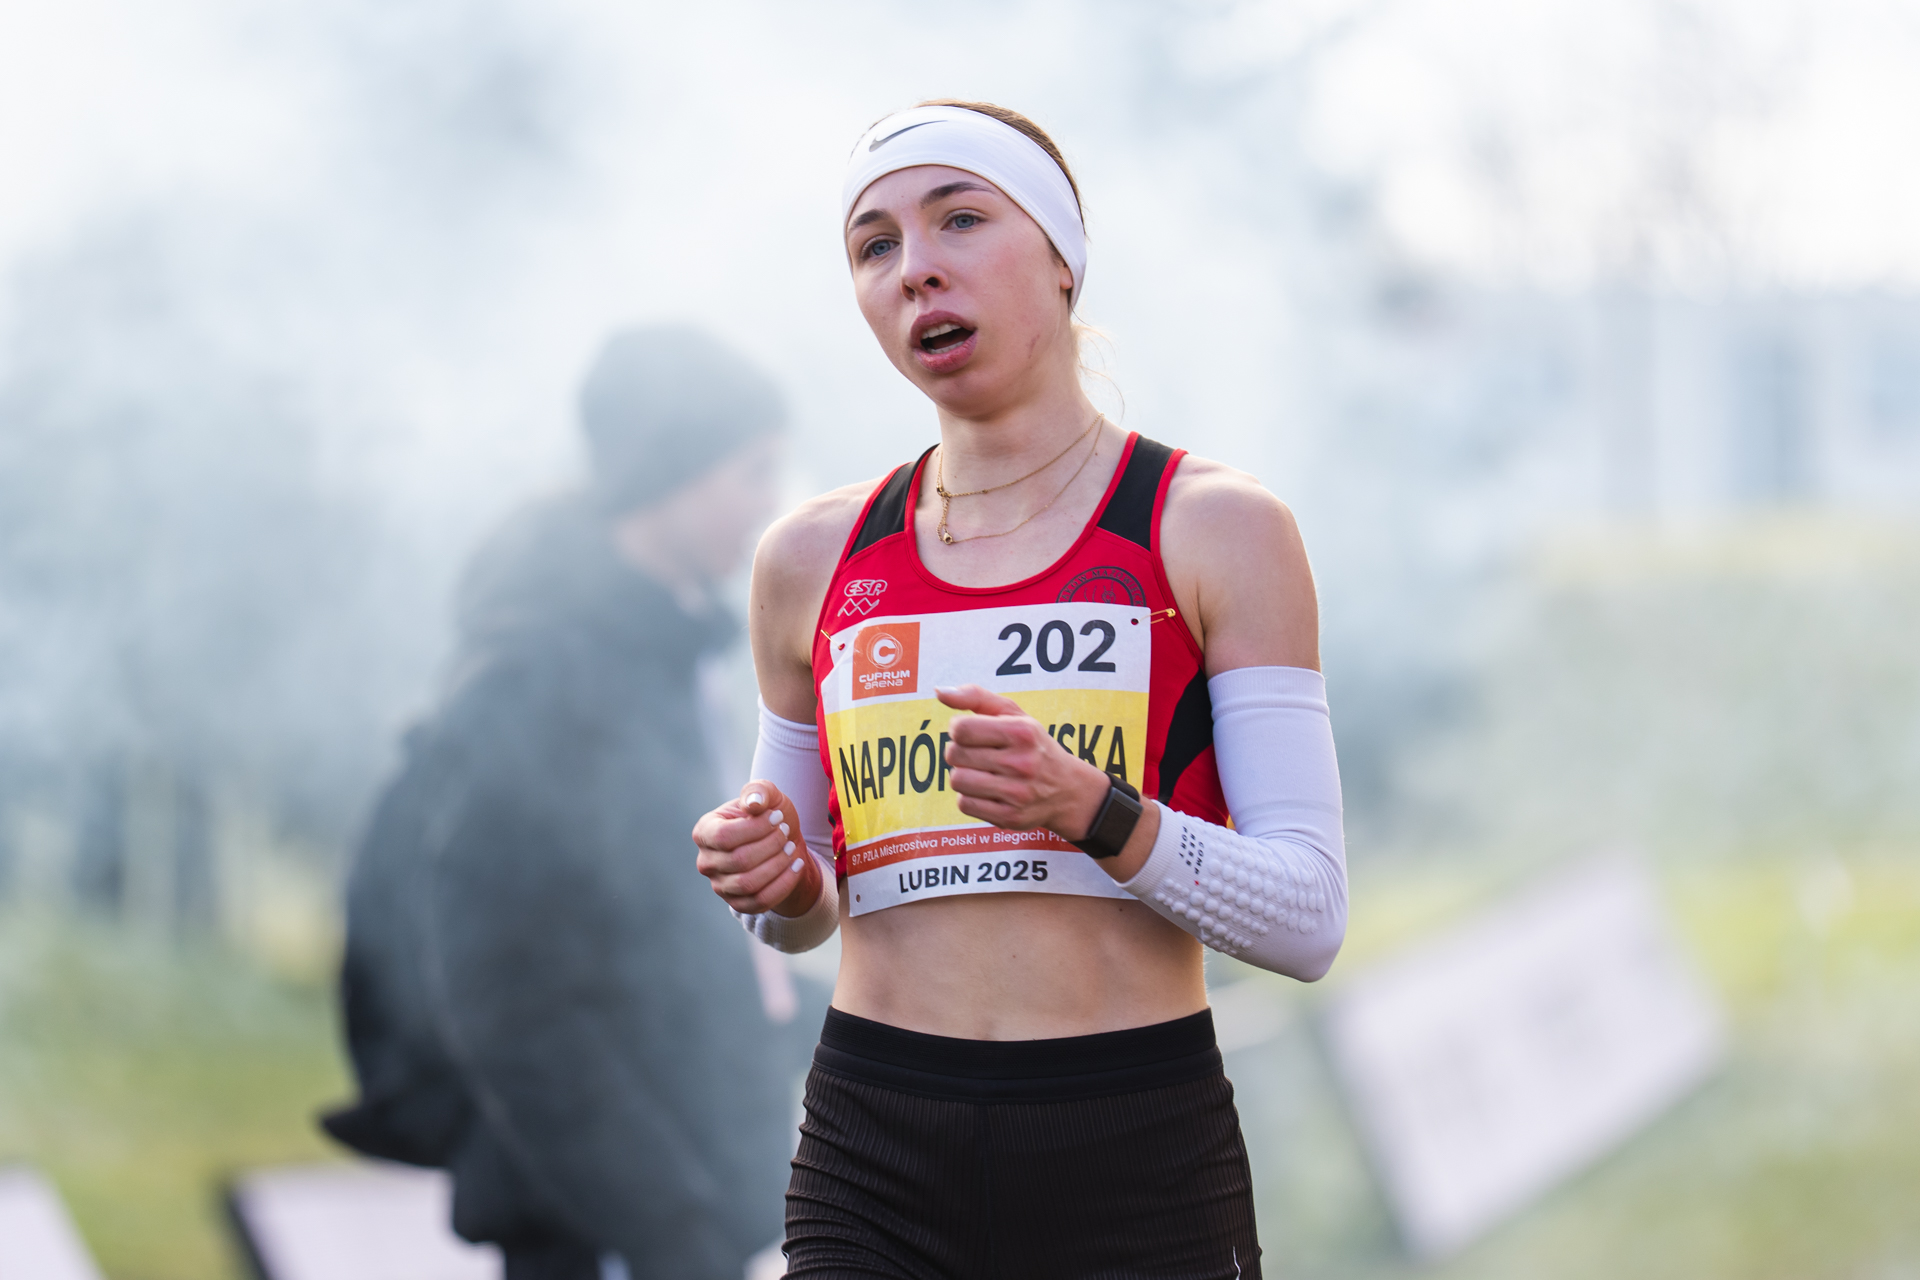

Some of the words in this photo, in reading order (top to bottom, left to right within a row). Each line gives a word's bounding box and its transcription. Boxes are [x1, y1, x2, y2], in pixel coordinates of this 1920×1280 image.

[1091, 568, 1144, 608] MAZOWIECK
[996, 619, 1117, 677] 202
[859, 670, 910, 683] CUPRUM
[839, 719, 1128, 809] NAPIÓRSKA
[852, 854, 862, 866] 97.
[863, 849, 879, 862] PZLA
[880, 839, 938, 858] Mistrzostwa
[941, 833, 976, 847] Polski
[979, 835, 990, 844] w
[993, 830, 1045, 845] Biegach
[899, 865, 969, 893] LUBIN
[977, 860, 1048, 882] 2025
